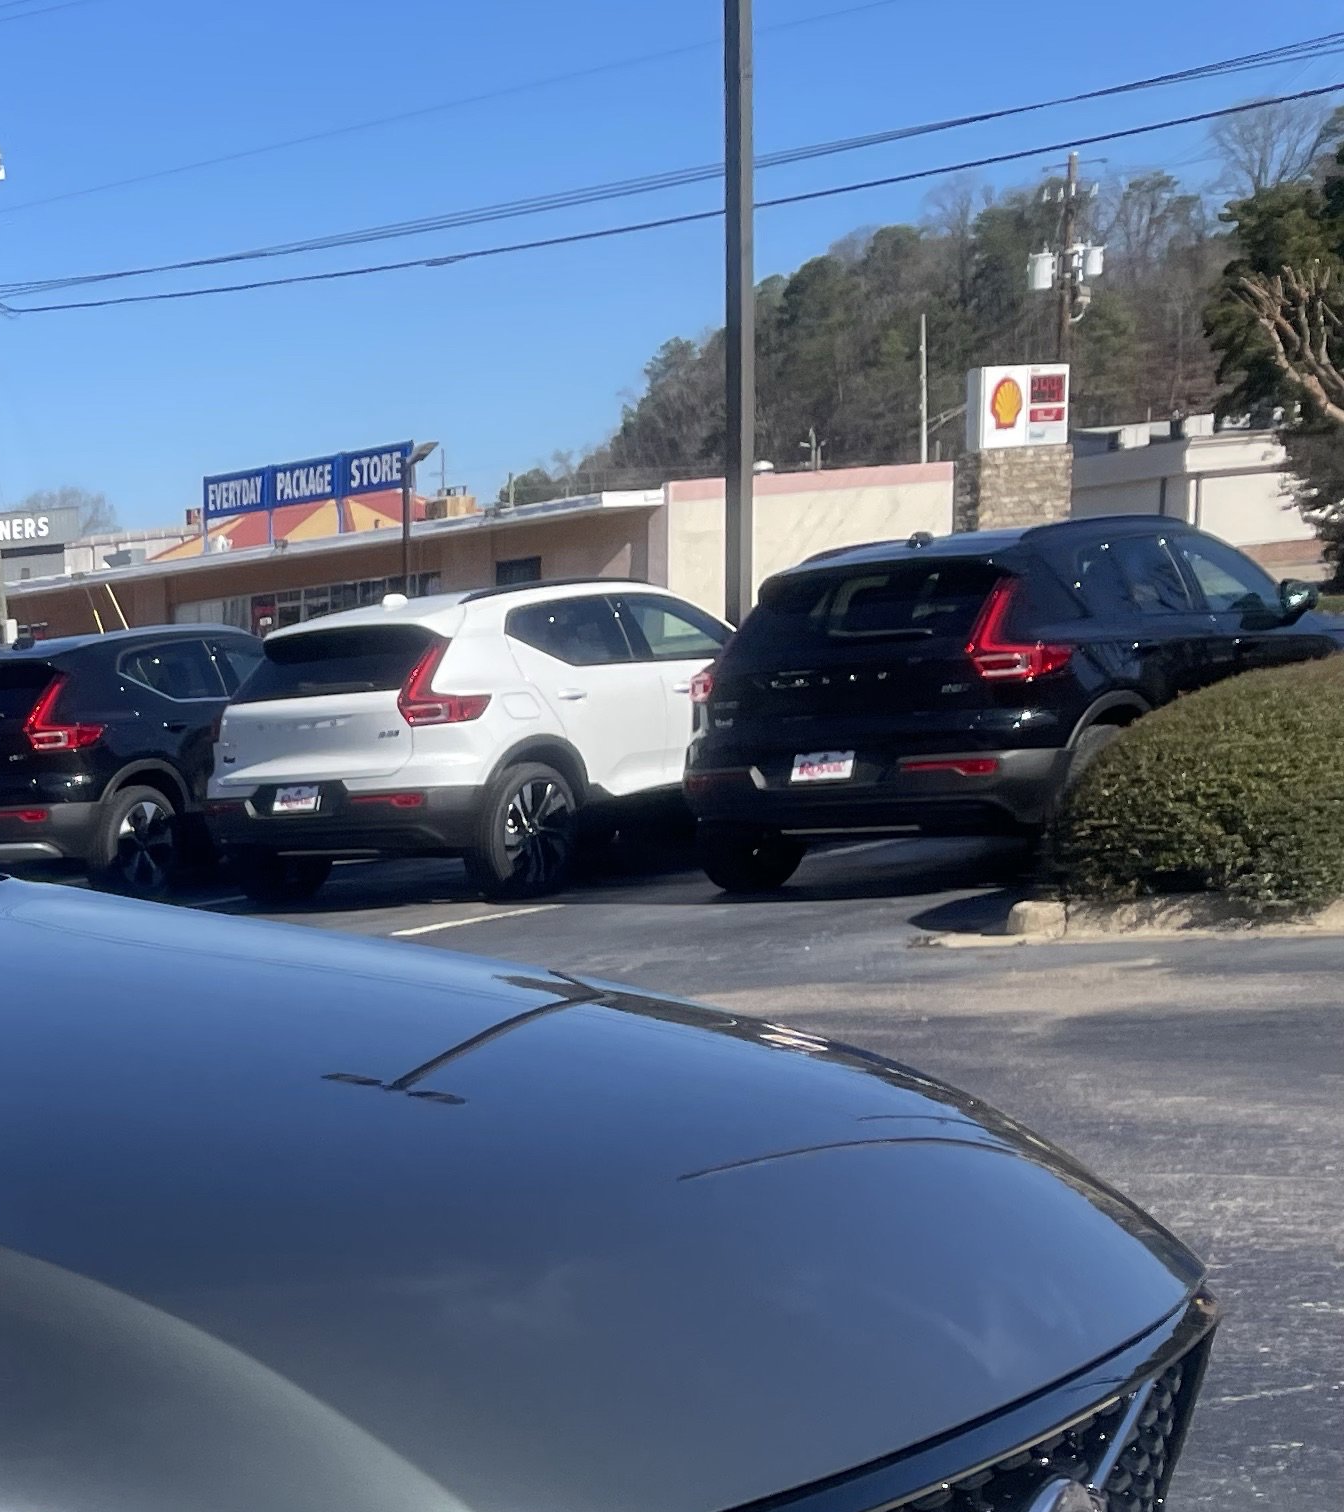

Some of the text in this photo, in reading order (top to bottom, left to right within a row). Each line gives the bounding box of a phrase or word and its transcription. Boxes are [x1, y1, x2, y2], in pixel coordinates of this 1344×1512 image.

[208, 452, 402, 511] EVERYDAY PACKAGE STORE
